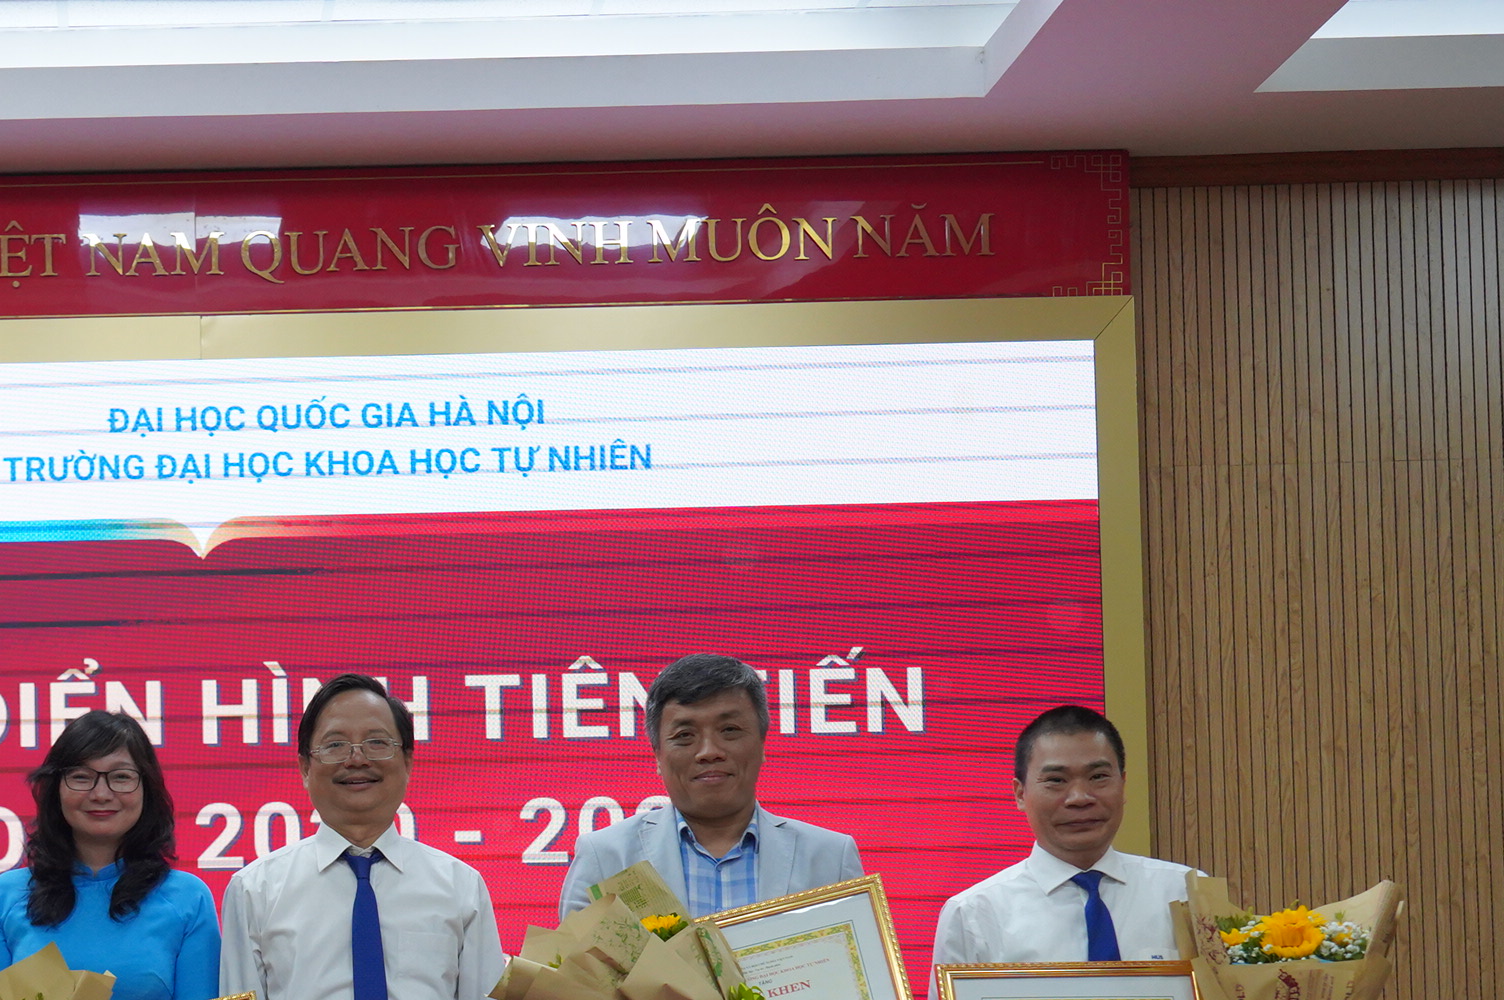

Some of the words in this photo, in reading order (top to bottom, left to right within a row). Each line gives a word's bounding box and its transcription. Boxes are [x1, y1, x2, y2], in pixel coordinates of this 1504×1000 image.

[82, 231, 225, 277] NAM
[240, 225, 461, 284] QUANG
[476, 220, 634, 268] VINH
[646, 203, 838, 263] MUÔN
[850, 203, 996, 259] NĂM
[107, 407, 163, 437] ĐẠI
[175, 405, 245, 437] HỌC
[256, 395, 350, 433] QUỐC
[361, 402, 419, 428] GIA
[429, 395, 476, 427] HÀ
[487, 393, 545, 430] NỘI
[3, 449, 145, 482] TRƯỜNG
[155, 453, 211, 484] ĐẠI
[223, 451, 293, 483] HỌC
[305, 450, 400, 477] KHOA
[410, 447, 481, 479] HỌC
[491, 445, 541, 478] TỰ
[548, 438, 652, 472] NHIÊN
[760, 646, 926, 735] IẾN
[767, 979, 812, 998] KHEN
